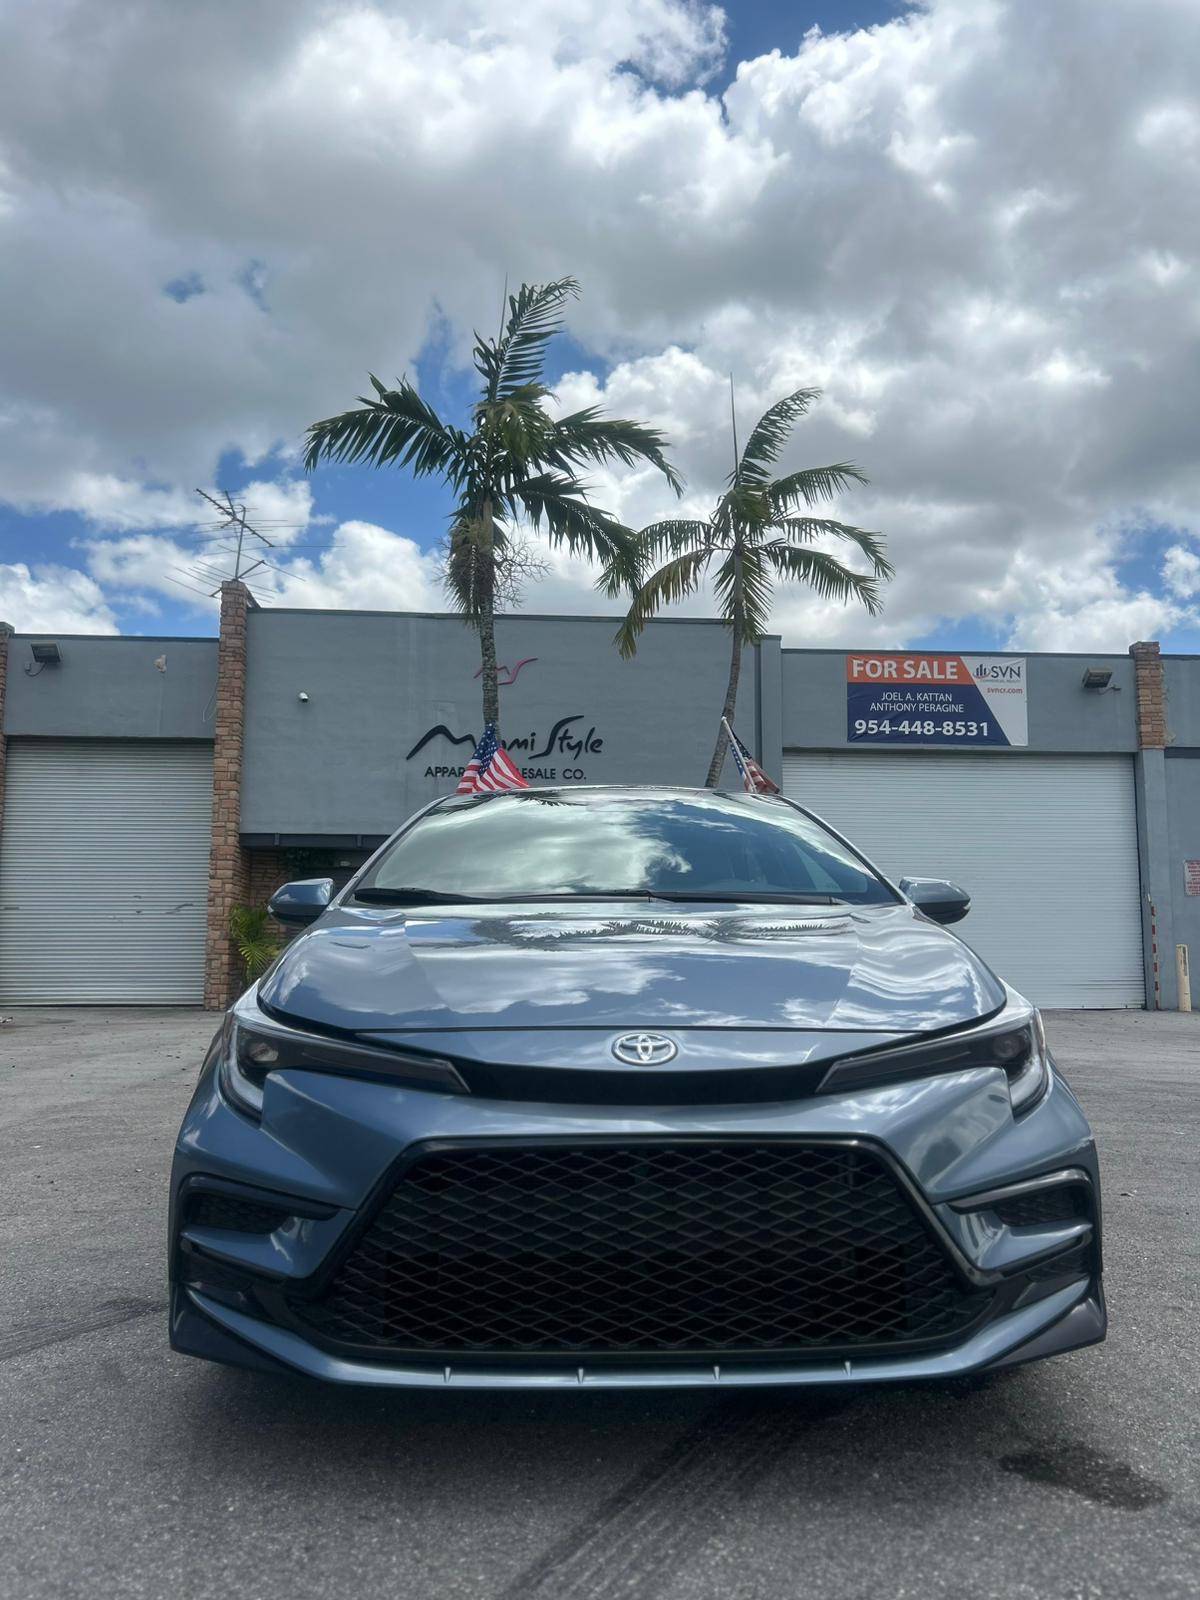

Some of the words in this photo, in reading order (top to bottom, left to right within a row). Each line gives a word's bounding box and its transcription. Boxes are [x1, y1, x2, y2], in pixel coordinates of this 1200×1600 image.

[852, 659, 898, 678] FOR
[903, 660, 958, 680] SALE
[991, 665, 1021, 679] SVN
[881, 691, 904, 701] JOEL
[905, 692, 914, 702] A.
[916, 692, 952, 702] KATTAN
[870, 702, 917, 713] ANTHONY
[918, 703, 964, 713] PERAGINE
[854, 719, 988, 737] 954-448-8531
[406, 724, 537, 760] Mmi
[528, 715, 604, 760] Style
[424, 766, 466, 778] APPAR
[562, 768, 587, 780] CO.
